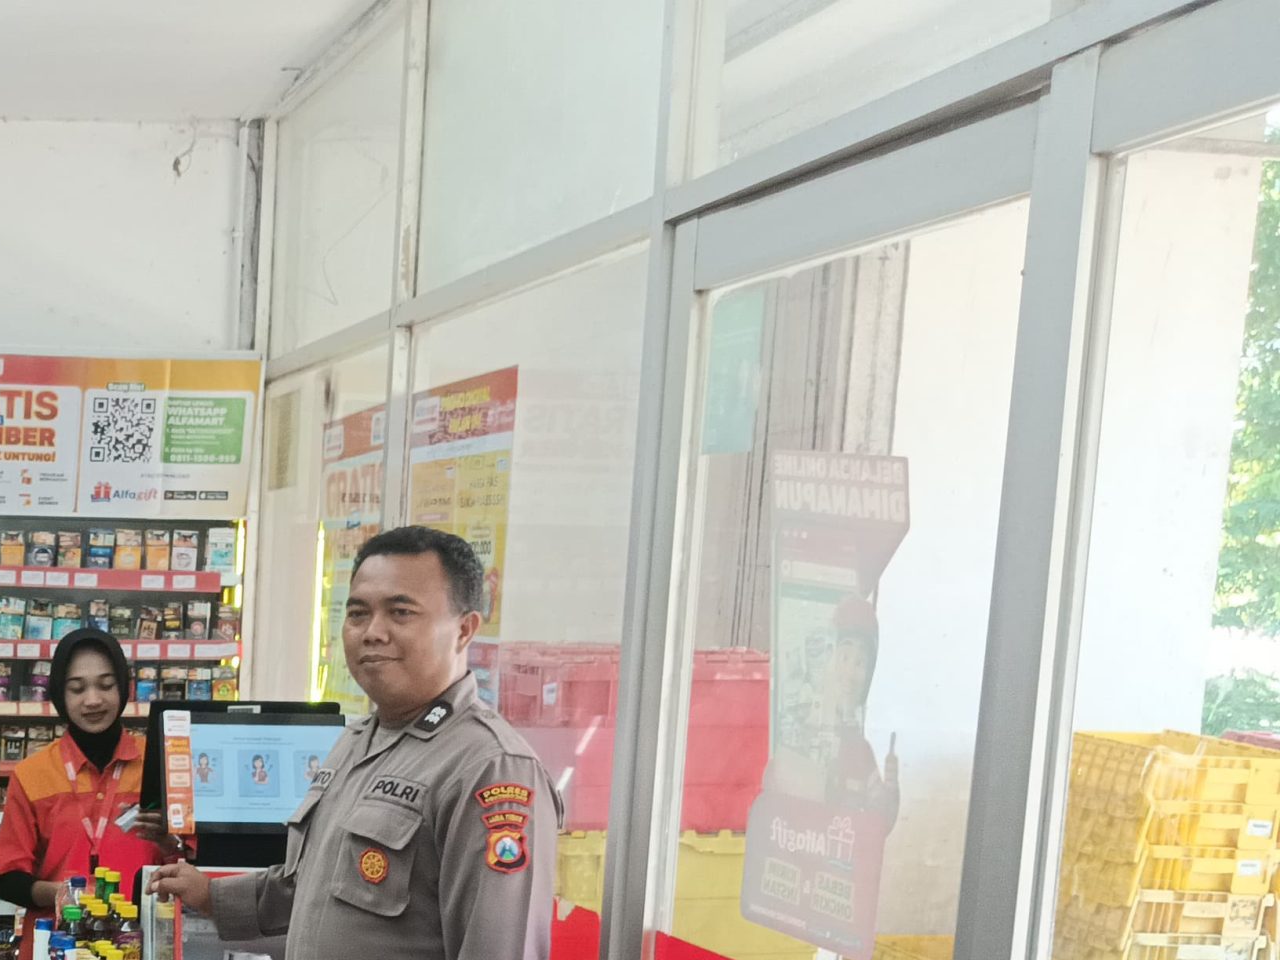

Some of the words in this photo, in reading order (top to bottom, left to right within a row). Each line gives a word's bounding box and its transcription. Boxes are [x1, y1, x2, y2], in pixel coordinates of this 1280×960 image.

[168, 406, 228, 416] WHATSAPP
[167, 416, 226, 426] ALFAMART
[3, 451, 56, 463] UNTUNG!
[371, 779, 420, 803] POLRI
[483, 786, 529, 798] POLRES
